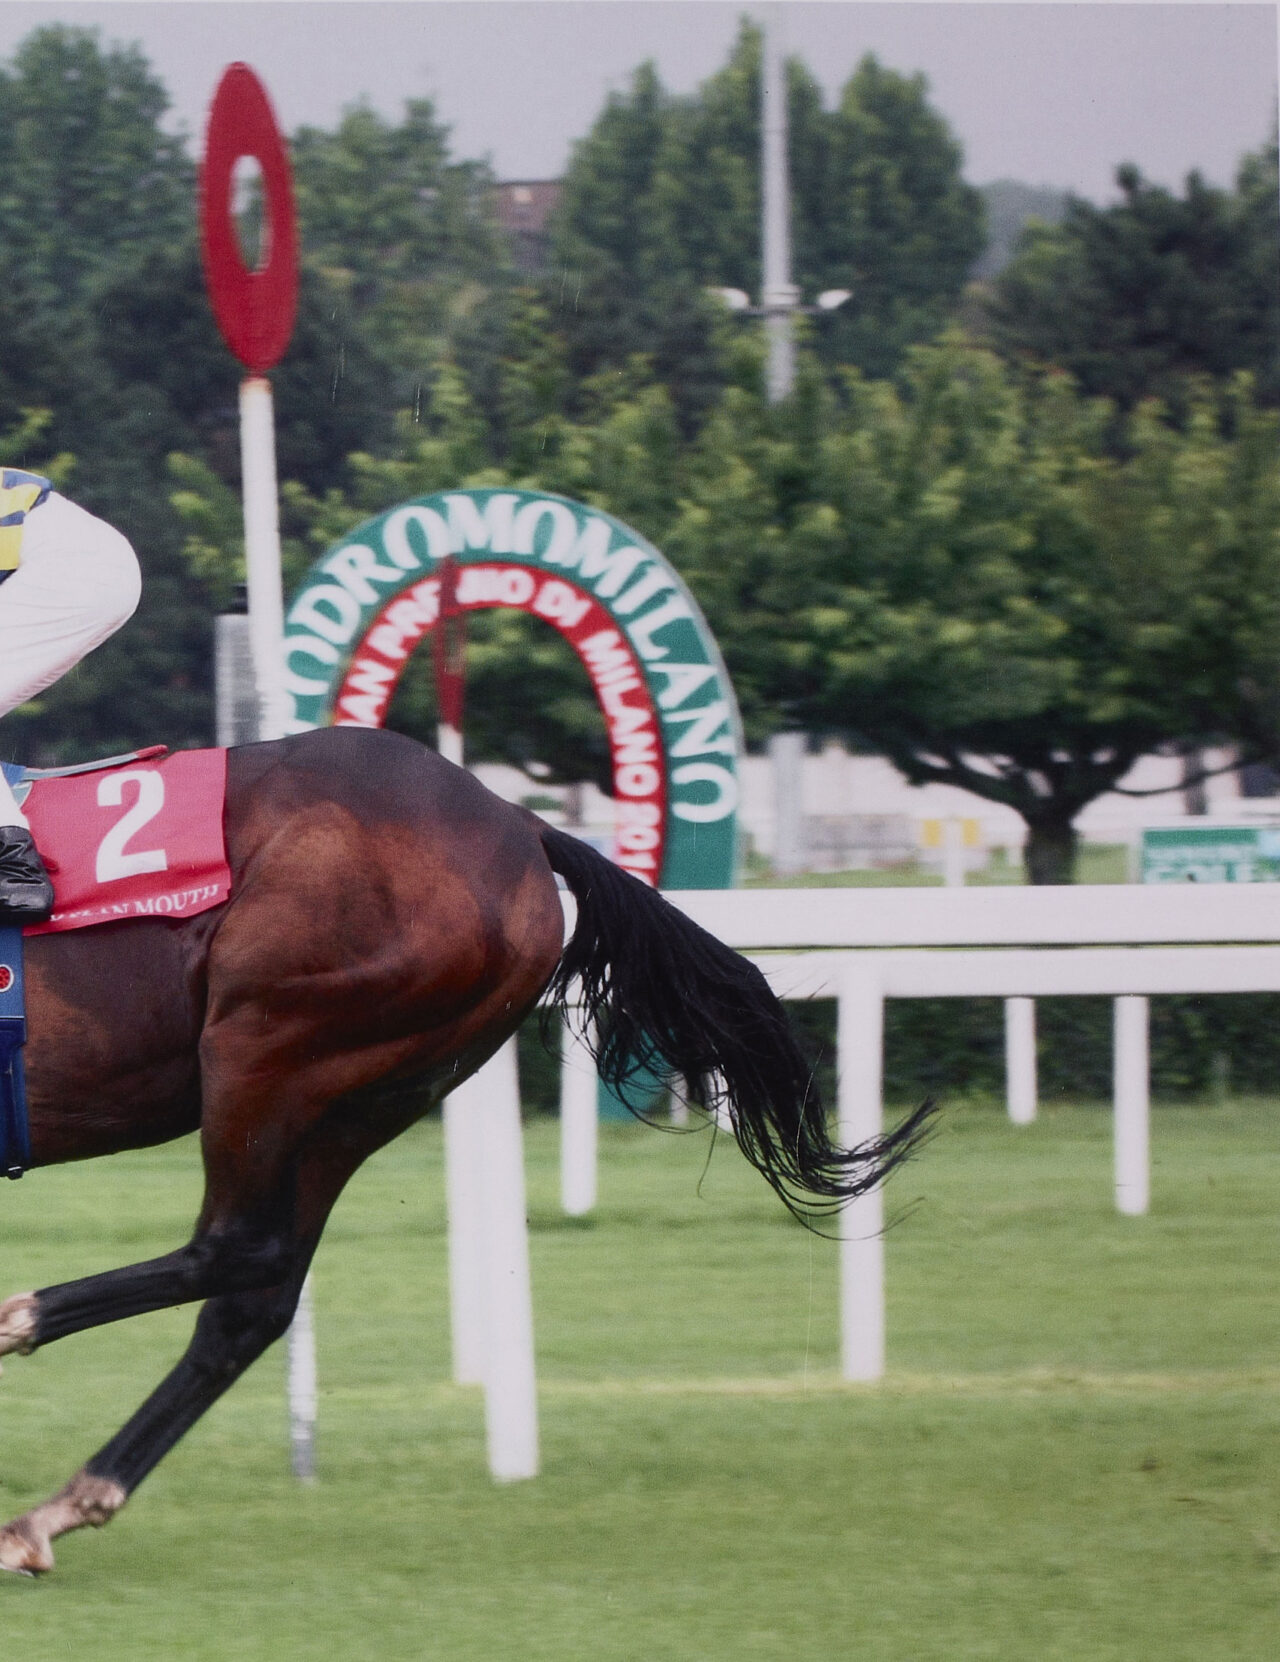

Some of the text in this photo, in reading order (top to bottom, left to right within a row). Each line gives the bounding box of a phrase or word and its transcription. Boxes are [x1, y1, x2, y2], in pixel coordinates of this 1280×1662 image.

[334, 657, 396, 728] AN
[532, 579, 593, 627] DI
[580, 629, 662, 797] MILANO
[96, 770, 168, 883] 2
